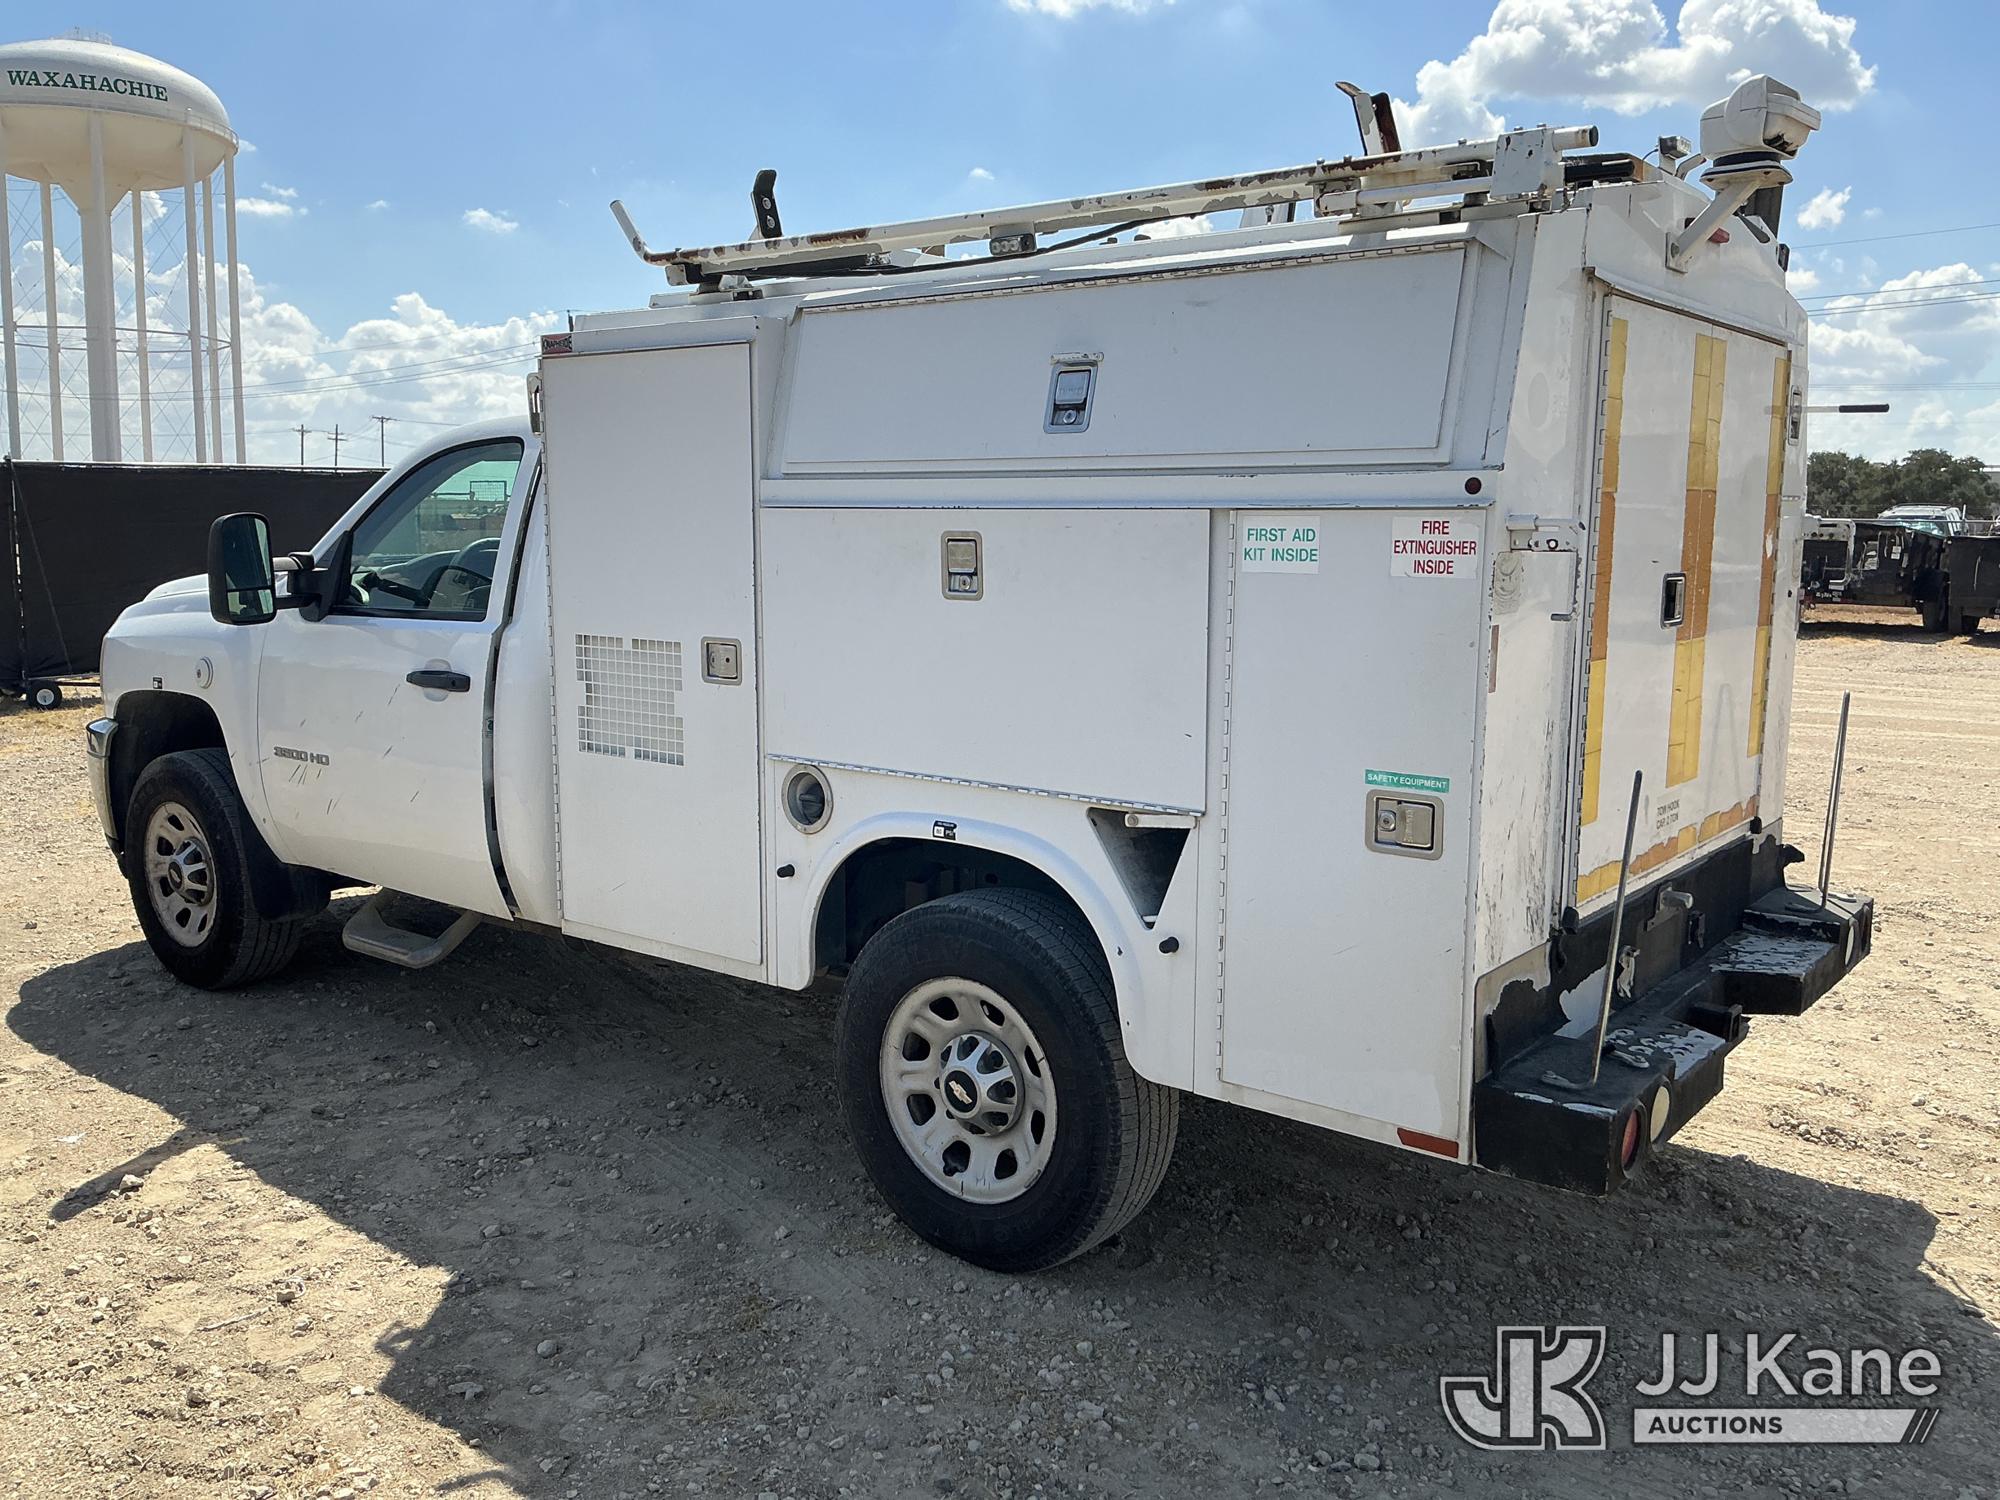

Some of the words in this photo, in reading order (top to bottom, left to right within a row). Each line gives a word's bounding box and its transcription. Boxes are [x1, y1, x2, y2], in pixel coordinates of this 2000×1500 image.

[7, 70, 168, 101] WAXAHACHIE
[1247, 528, 1287, 542] FIRST
[1292, 528, 1316, 542] AID
[1421, 520, 1450, 535] FIRE
[1243, 547, 1266, 561] KIT
[1271, 548, 1318, 562] INSIDE
[1393, 540, 1477, 555] EXTINGUISHER
[1413, 559, 1454, 574] INSIDE
[273, 746, 309, 762] 3500
[310, 752, 330, 766] HD
[1367, 773, 1399, 783] SAFETY
[1399, 776, 1447, 788] EQUIPMENT
[1657, 805, 1666, 816] TOW
[1667, 799, 1680, 811] HOOK
